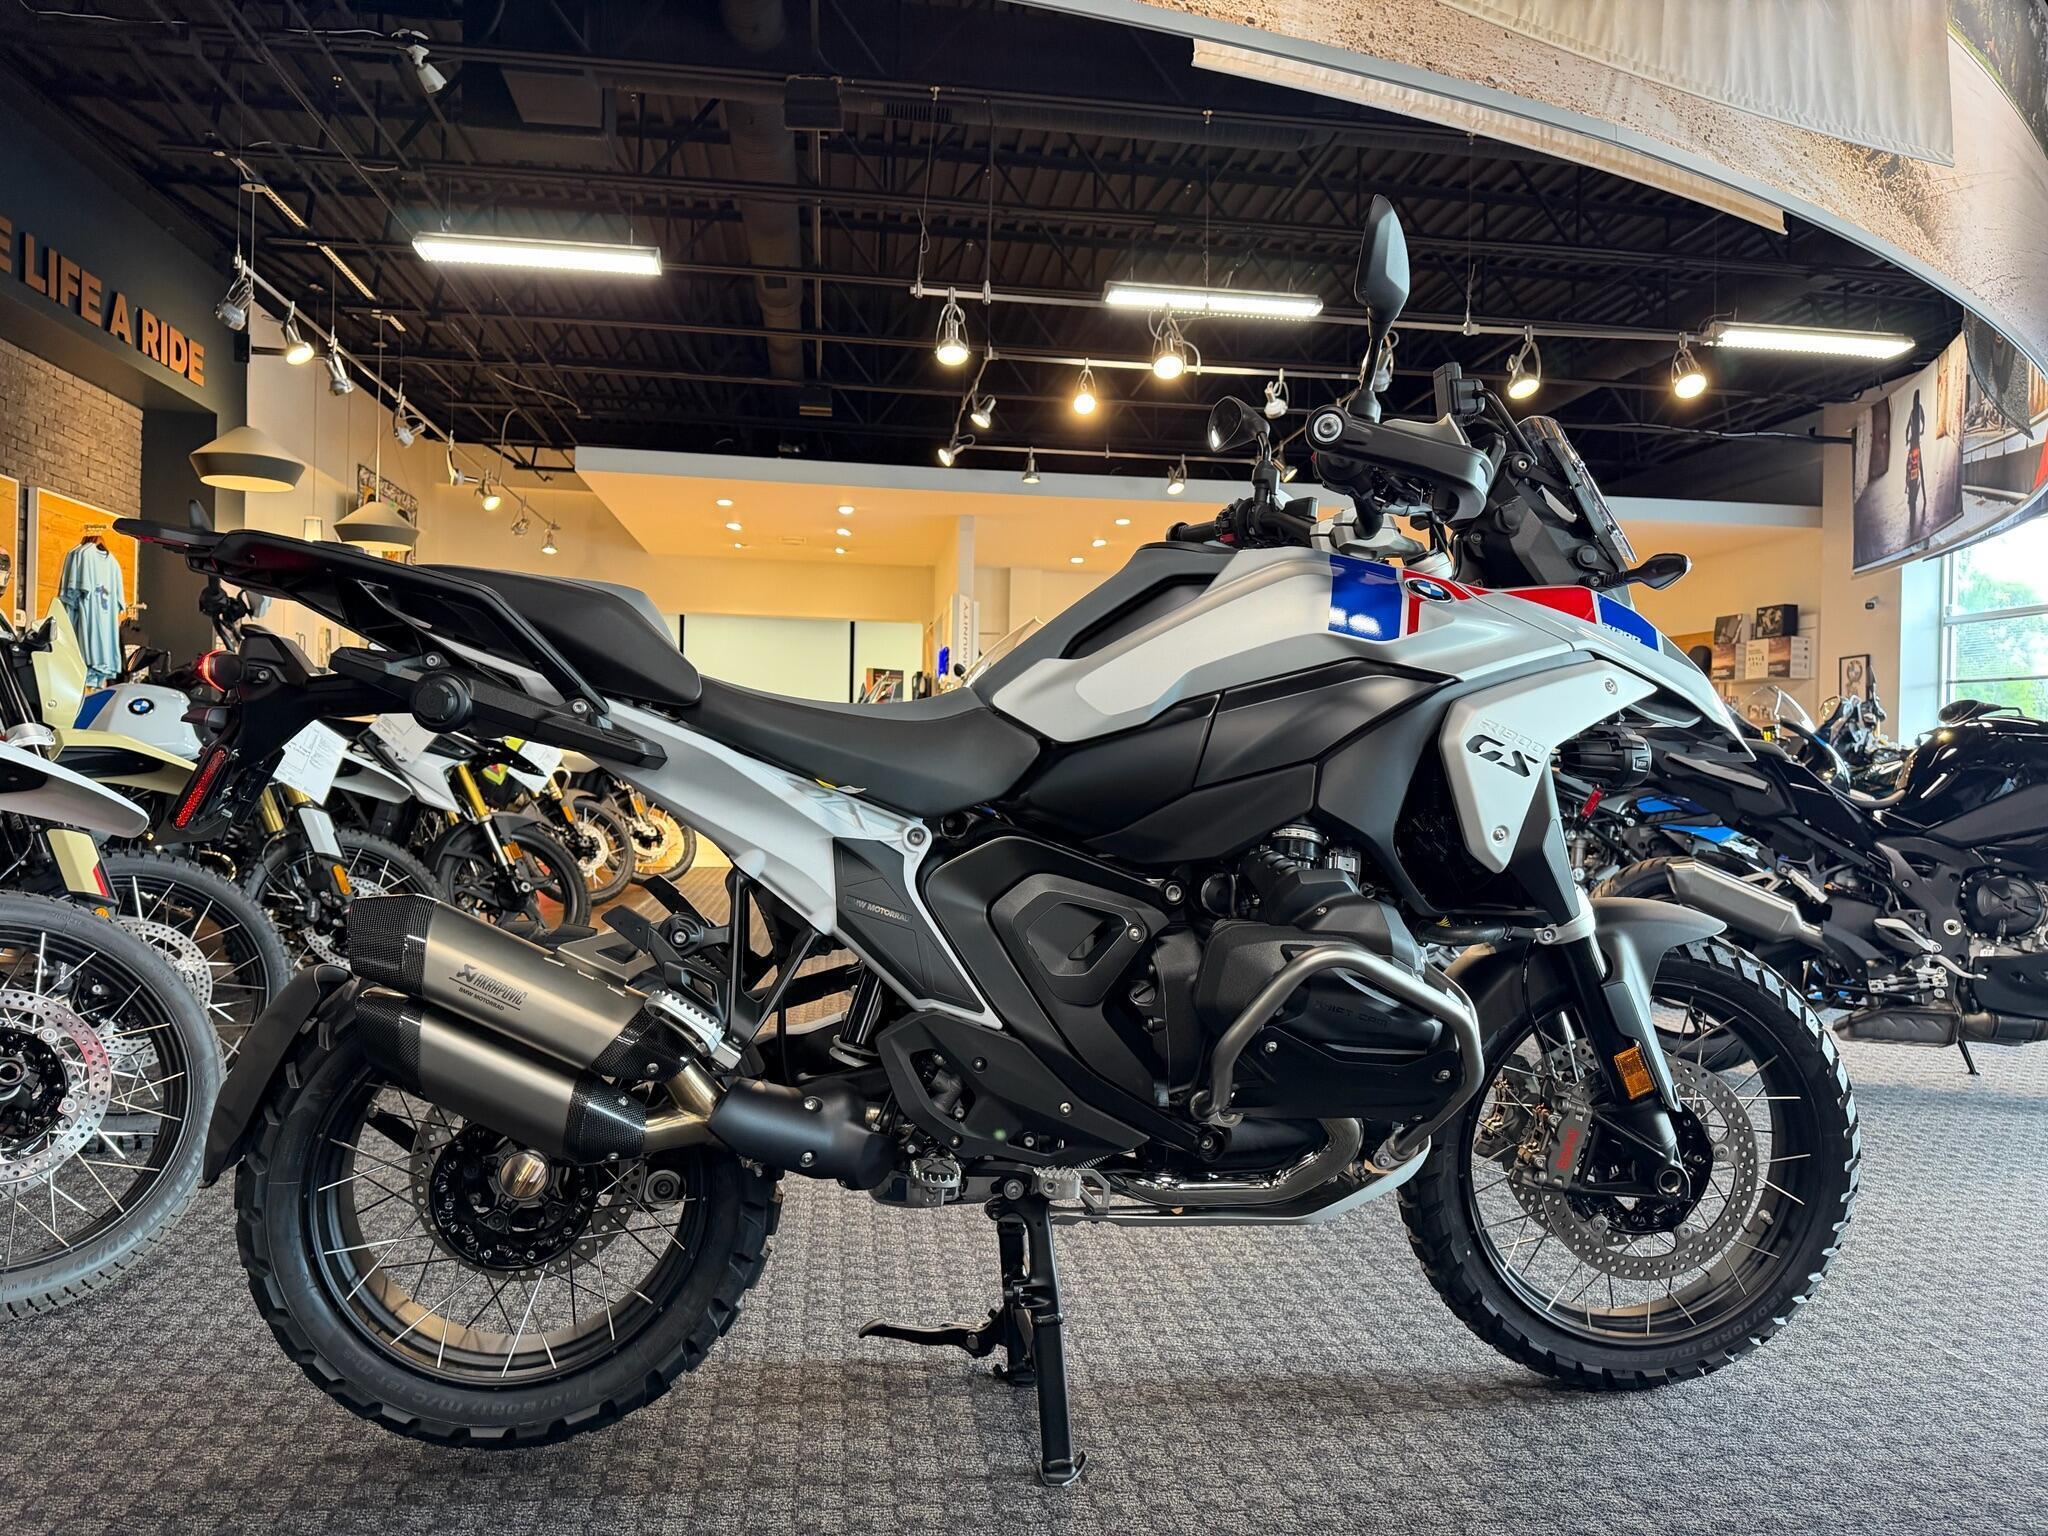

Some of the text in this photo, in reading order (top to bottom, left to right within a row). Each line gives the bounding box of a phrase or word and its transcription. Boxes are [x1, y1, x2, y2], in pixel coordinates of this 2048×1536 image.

[25, 232, 102, 327] LIFE
[109, 292, 132, 344] A
[142, 308, 205, 387] RIDE
[1466, 734, 1541, 777] GS
[459, 986, 505, 1011] BMW MOTORRAD
